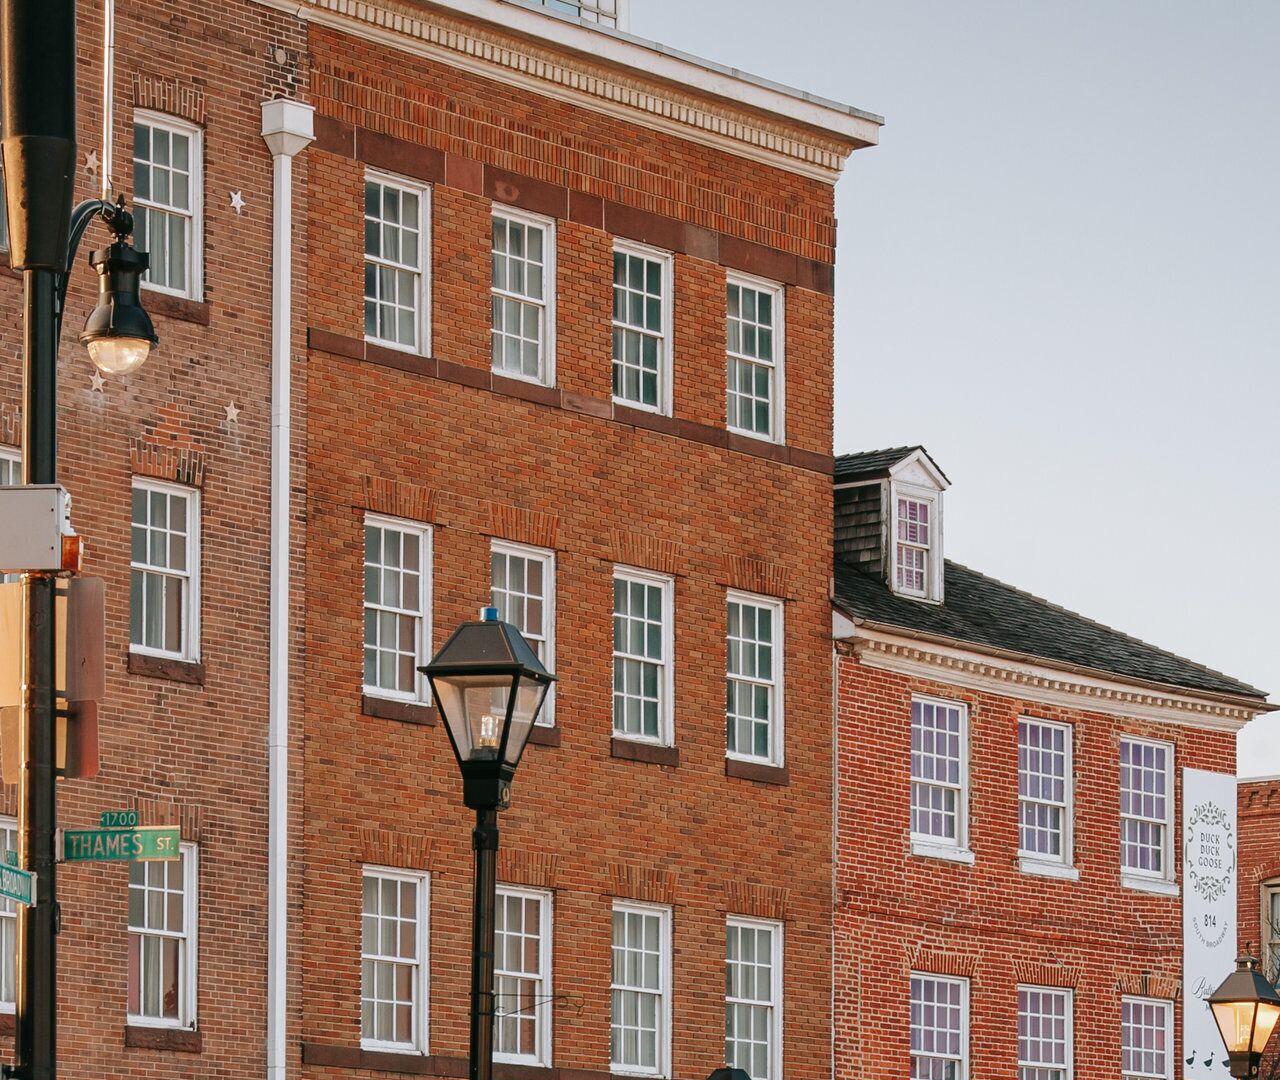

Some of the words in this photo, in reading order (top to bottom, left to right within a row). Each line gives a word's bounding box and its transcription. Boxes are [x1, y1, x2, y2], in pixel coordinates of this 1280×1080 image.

[105, 812, 137, 826] 1700
[69, 833, 144, 857] THAMES
[156, 836, 175, 851] ST.
[1200, 832, 1220, 845] DUCK
[1200, 844, 1220, 857] DUCK
[1198, 856, 1222, 869] GOOSE
[1203, 914, 1217, 928] 814
[1192, 916, 1205, 945] SOUTH
[1205, 920, 1229, 948] BROADWAY
